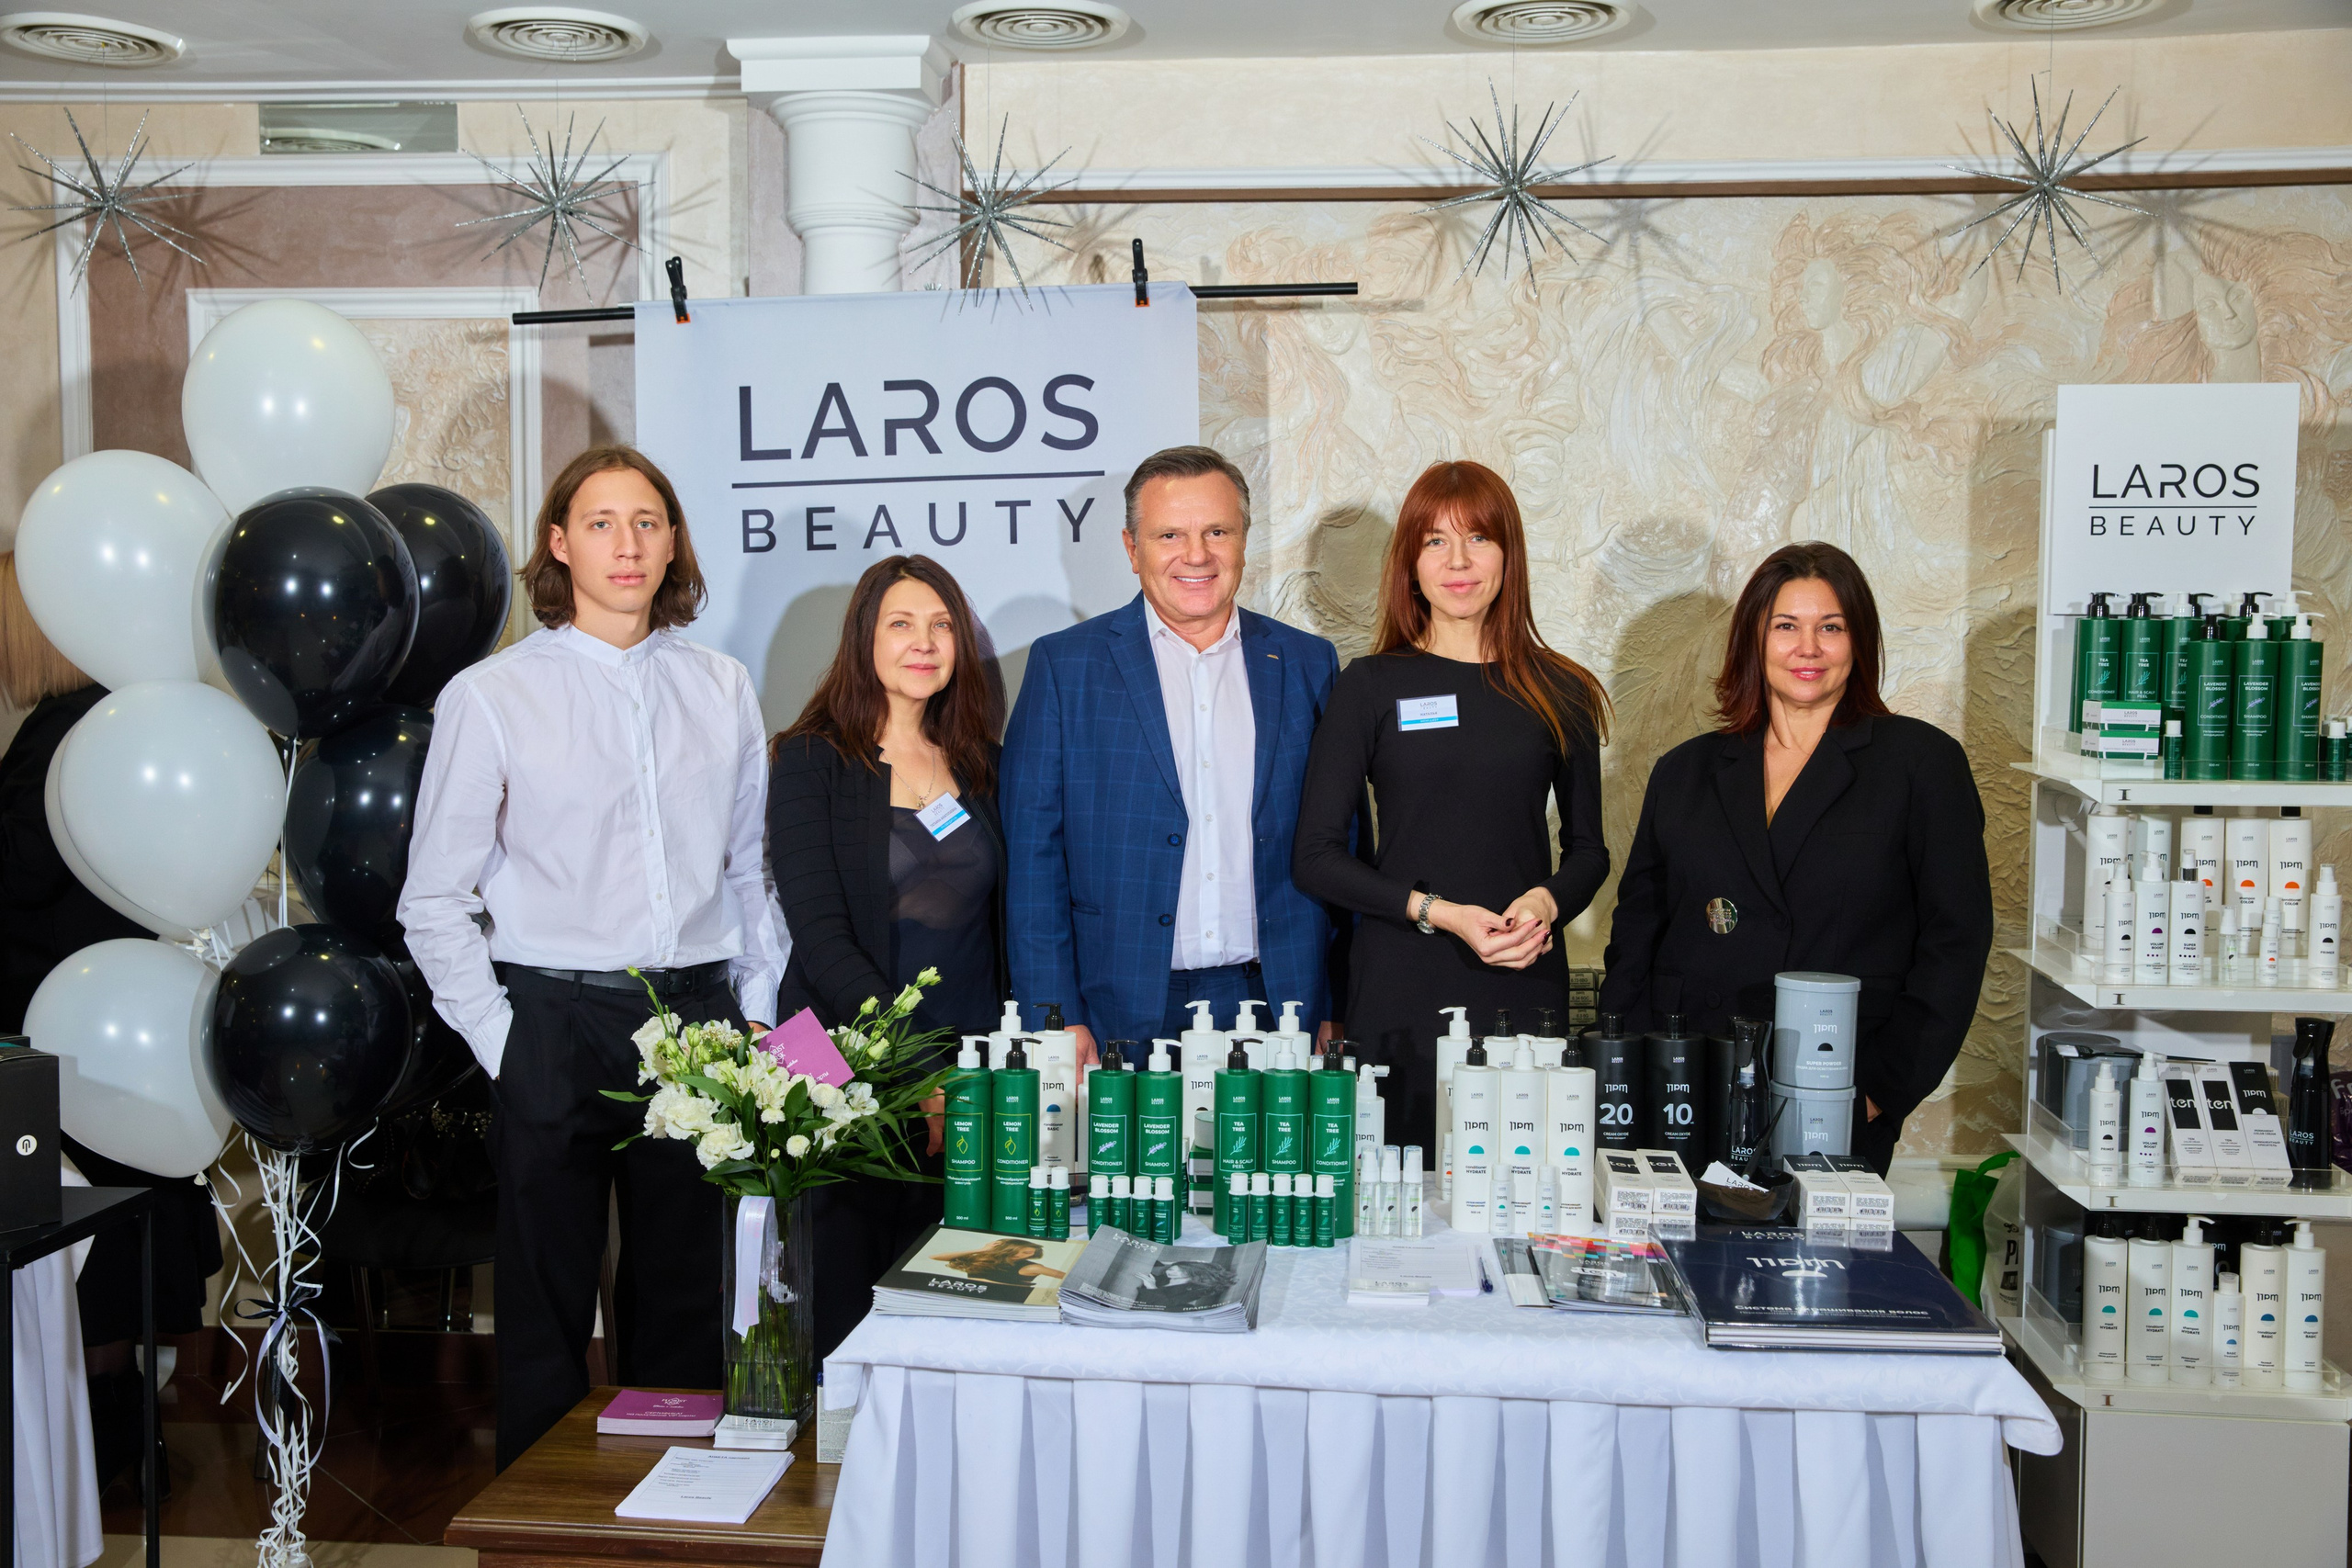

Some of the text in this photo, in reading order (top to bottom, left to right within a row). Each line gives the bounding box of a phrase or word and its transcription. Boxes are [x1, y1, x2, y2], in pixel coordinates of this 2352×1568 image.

[739, 374, 1099, 462] LAROS
[2092, 463, 2260, 499] LAROS
[741, 497, 1095, 553] BEAUTY
[2090, 515, 2256, 536] BEAUTY
[1600, 1103, 1634, 1125] 20
[1663, 1103, 1693, 1125] 10
[2207, 1099, 2233, 1110] ten
[2290, 1130, 2314, 1140] LAROS
[1725, 1177, 1755, 1189] LARO
[930, 1278, 988, 1291] LAROS
